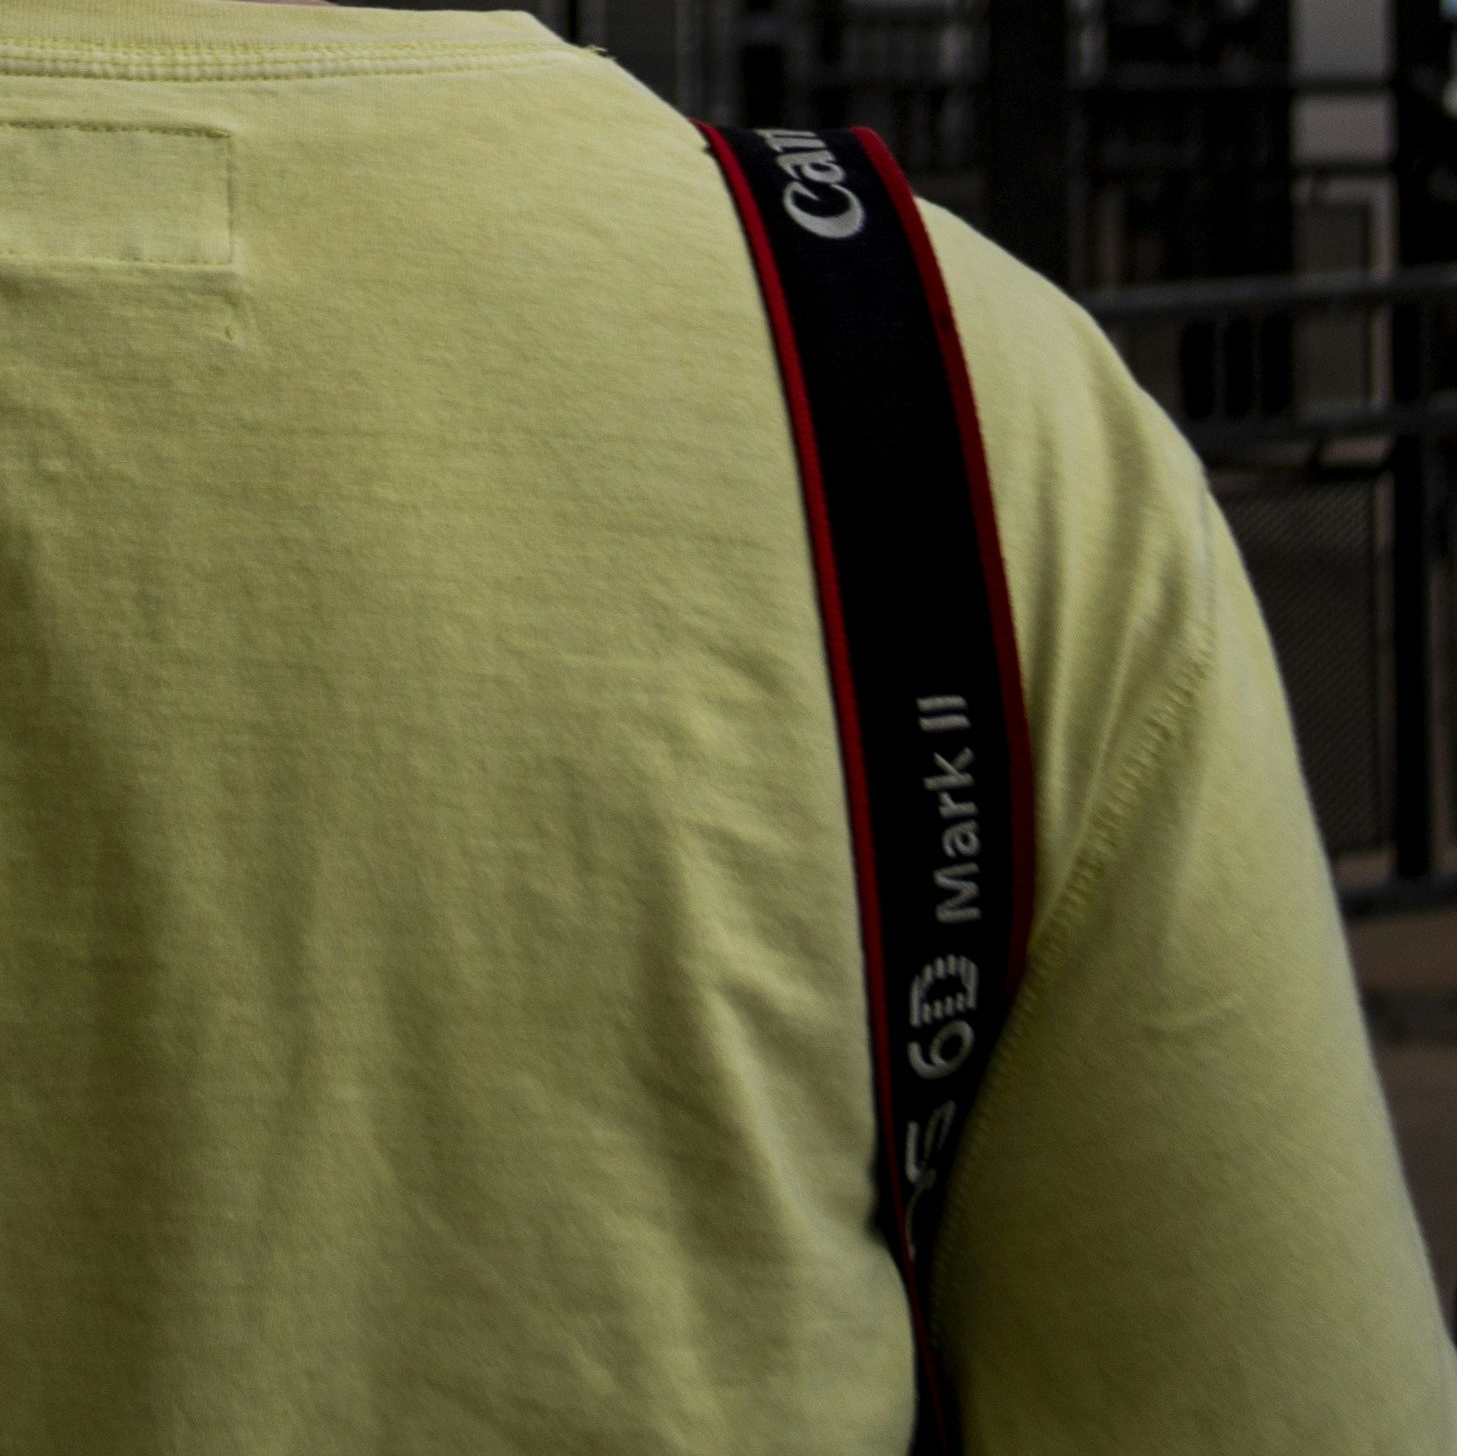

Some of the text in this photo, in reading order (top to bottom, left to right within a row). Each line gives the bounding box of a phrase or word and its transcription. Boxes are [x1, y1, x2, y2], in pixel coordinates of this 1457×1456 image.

[915, 693, 971, 735] II
[922, 747, 982, 923] Mark
[906, 954, 980, 1080] 6D
